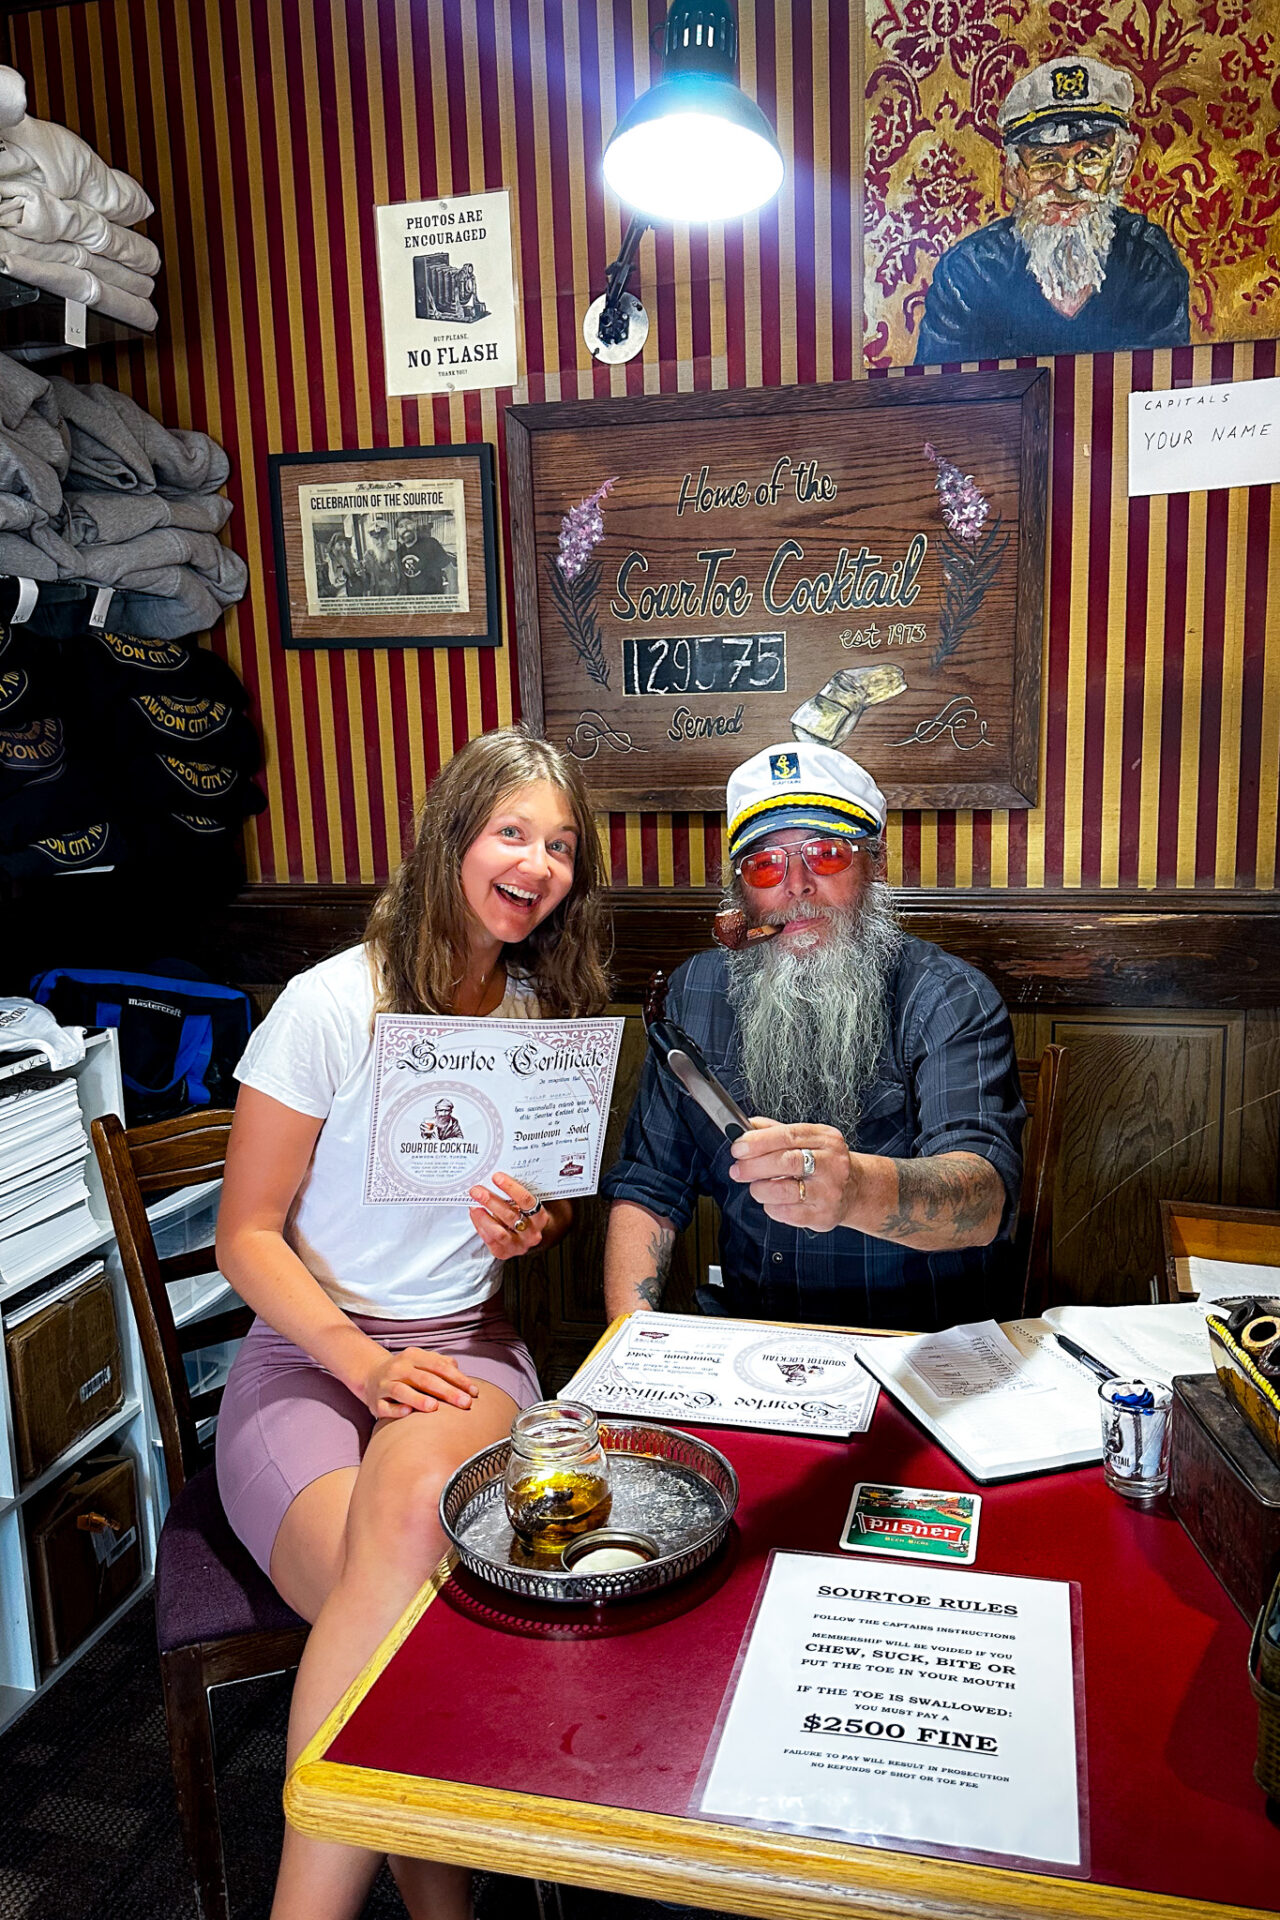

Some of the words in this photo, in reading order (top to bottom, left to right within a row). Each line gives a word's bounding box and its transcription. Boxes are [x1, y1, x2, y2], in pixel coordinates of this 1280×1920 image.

[406, 213, 455, 229] PHOTOS
[458, 209, 483, 224] ARE
[404, 227, 487, 248] ENCOURAGED
[407, 349, 431, 368] NO
[437, 343, 498, 365] FLASH
[1144, 393, 1230, 411] CAPITALS
[1144, 429, 1193, 451] YOUR
[1211, 423, 1272, 442] NAME
[676, 466, 751, 516] Home
[754, 455, 791, 507] of
[791, 459, 838, 503] the
[310, 495, 368, 510] CELEBRATION
[370, 494, 381, 508] OF
[383, 493, 401, 507] THE
[403, 491, 444, 506] SOURTOE
[610, 547, 754, 623] SourToe
[763, 533, 928, 616] Cocktail
[839, 622, 882, 650] est
[887, 622, 926, 646] 1973
[139, 696, 186, 732] AWSON
[667, 703, 746, 742] Served
[128, 997, 182, 1018] Mastercraft
[397, 1038, 496, 1077] Sourtoe
[504, 1039, 605, 1080] Certificate
[514, 1129, 560, 1142] Downtown
[566, 1123, 590, 1134] Hotel
[400, 1142, 438, 1154] SOURTOE
[440, 1142, 480, 1154] COCKTAIL
[868, 1518, 958, 1538] Pilsner
[817, 1585, 931, 1606] SOURTOE
[938, 1597, 1019, 1615] RULES
[813, 1613, 855, 1623] FOLLOW
[882, 1621, 934, 1631] CAPTAINS
[936, 1627, 1016, 1640] INSTRUCTIONS
[805, 1643, 865, 1658] CHEW,
[872, 1649, 929, 1665] SUCK,
[936, 1656, 981, 1671] BITE
[987, 1664, 1016, 1675] OR
[812, 1632, 883, 1644] MEMBERSHIP
[885, 1639, 911, 1648] WILL
[931, 1645, 973, 1655] VOIDED
[990, 1652, 1013, 1660] YOU
[801, 1658, 828, 1667] PUT
[832, 1661, 862, 1671] THE
[865, 1664, 895, 1674] TOE
[899, 1668, 914, 1676] IN
[918, 1670, 959, 1682] YOUR
[962, 1676, 1016, 1690] MOUTH
[797, 1685, 813, 1693] IF
[817, 1686, 848, 1696] THE
[852, 1690, 884, 1700] TOE
[889, 1693, 904, 1702] IS
[909, 1696, 1013, 1718] SWALLOWED:
[854, 1703, 879, 1712] YOU
[881, 1706, 913, 1716] MUST
[917, 1711, 939, 1720] PAY
[803, 1713, 906, 1739] $2500
[917, 1726, 999, 1753] FINE
[782, 1748, 822, 1757] FAILURE
[863, 1757, 885, 1765] WILL
[888, 1760, 925, 1770] RESULT
[941, 1767, 1010, 1782] PROSECUTION
[827, 1763, 871, 1773] REFUNDS
[890, 1771, 916, 1779] SHOT
[936, 1777, 957, 1785] TOE
[959, 1780, 979, 1789] FEE
